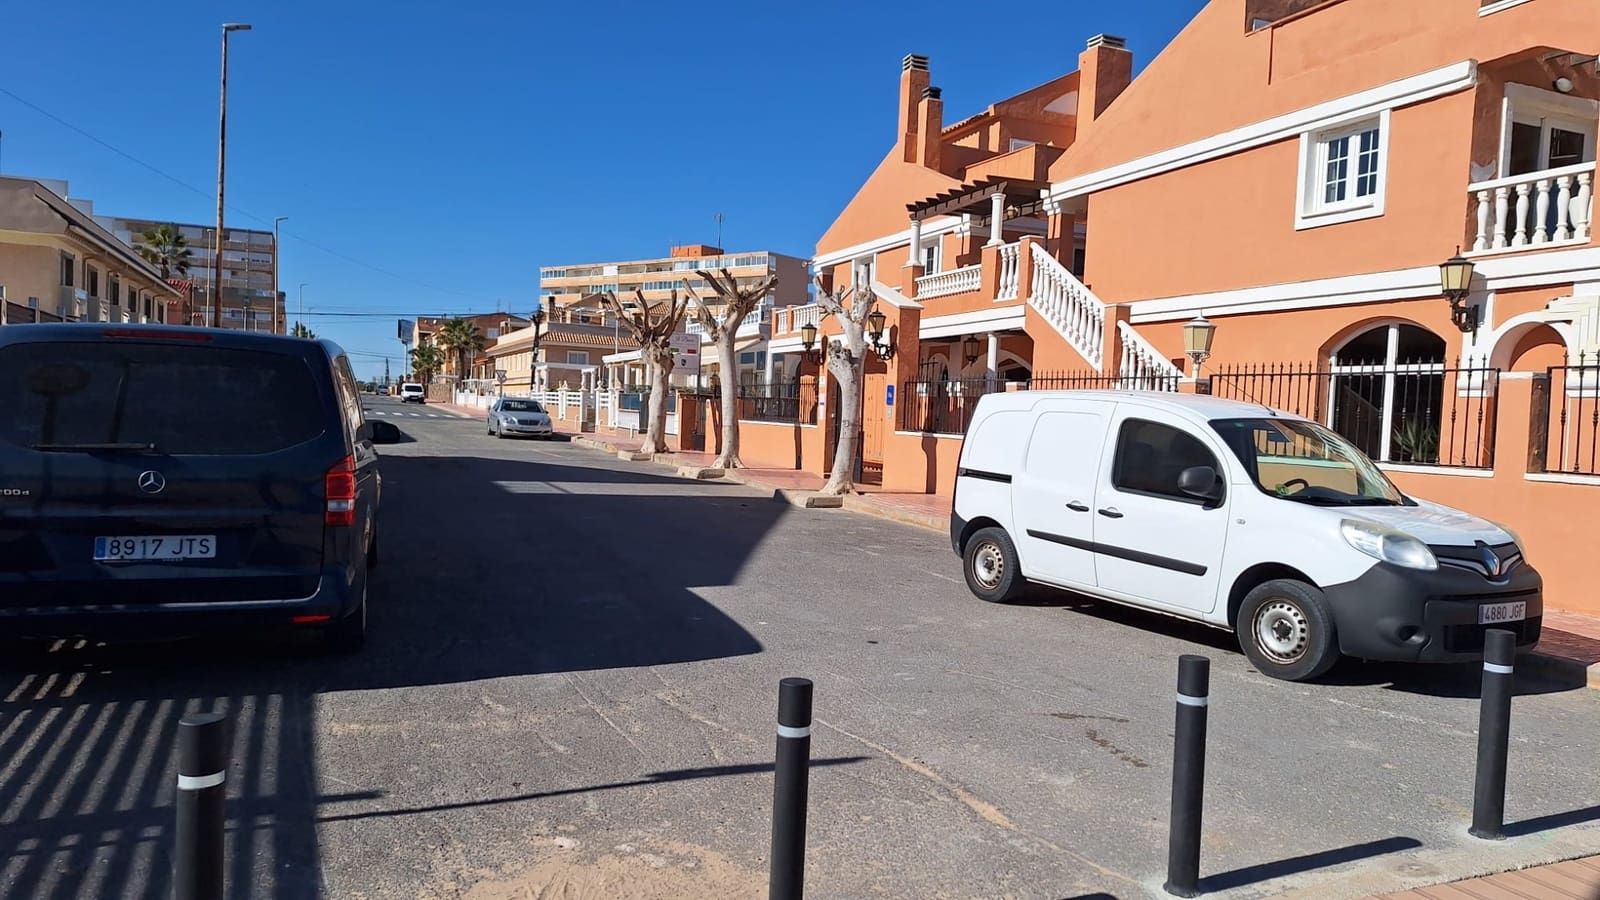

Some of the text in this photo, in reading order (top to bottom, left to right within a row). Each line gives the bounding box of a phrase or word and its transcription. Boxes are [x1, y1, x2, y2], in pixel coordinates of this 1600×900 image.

[0, 488, 30, 496] 00d
[109, 537, 210, 556] 8917 JTS
[1484, 606, 1507, 621] 4880
